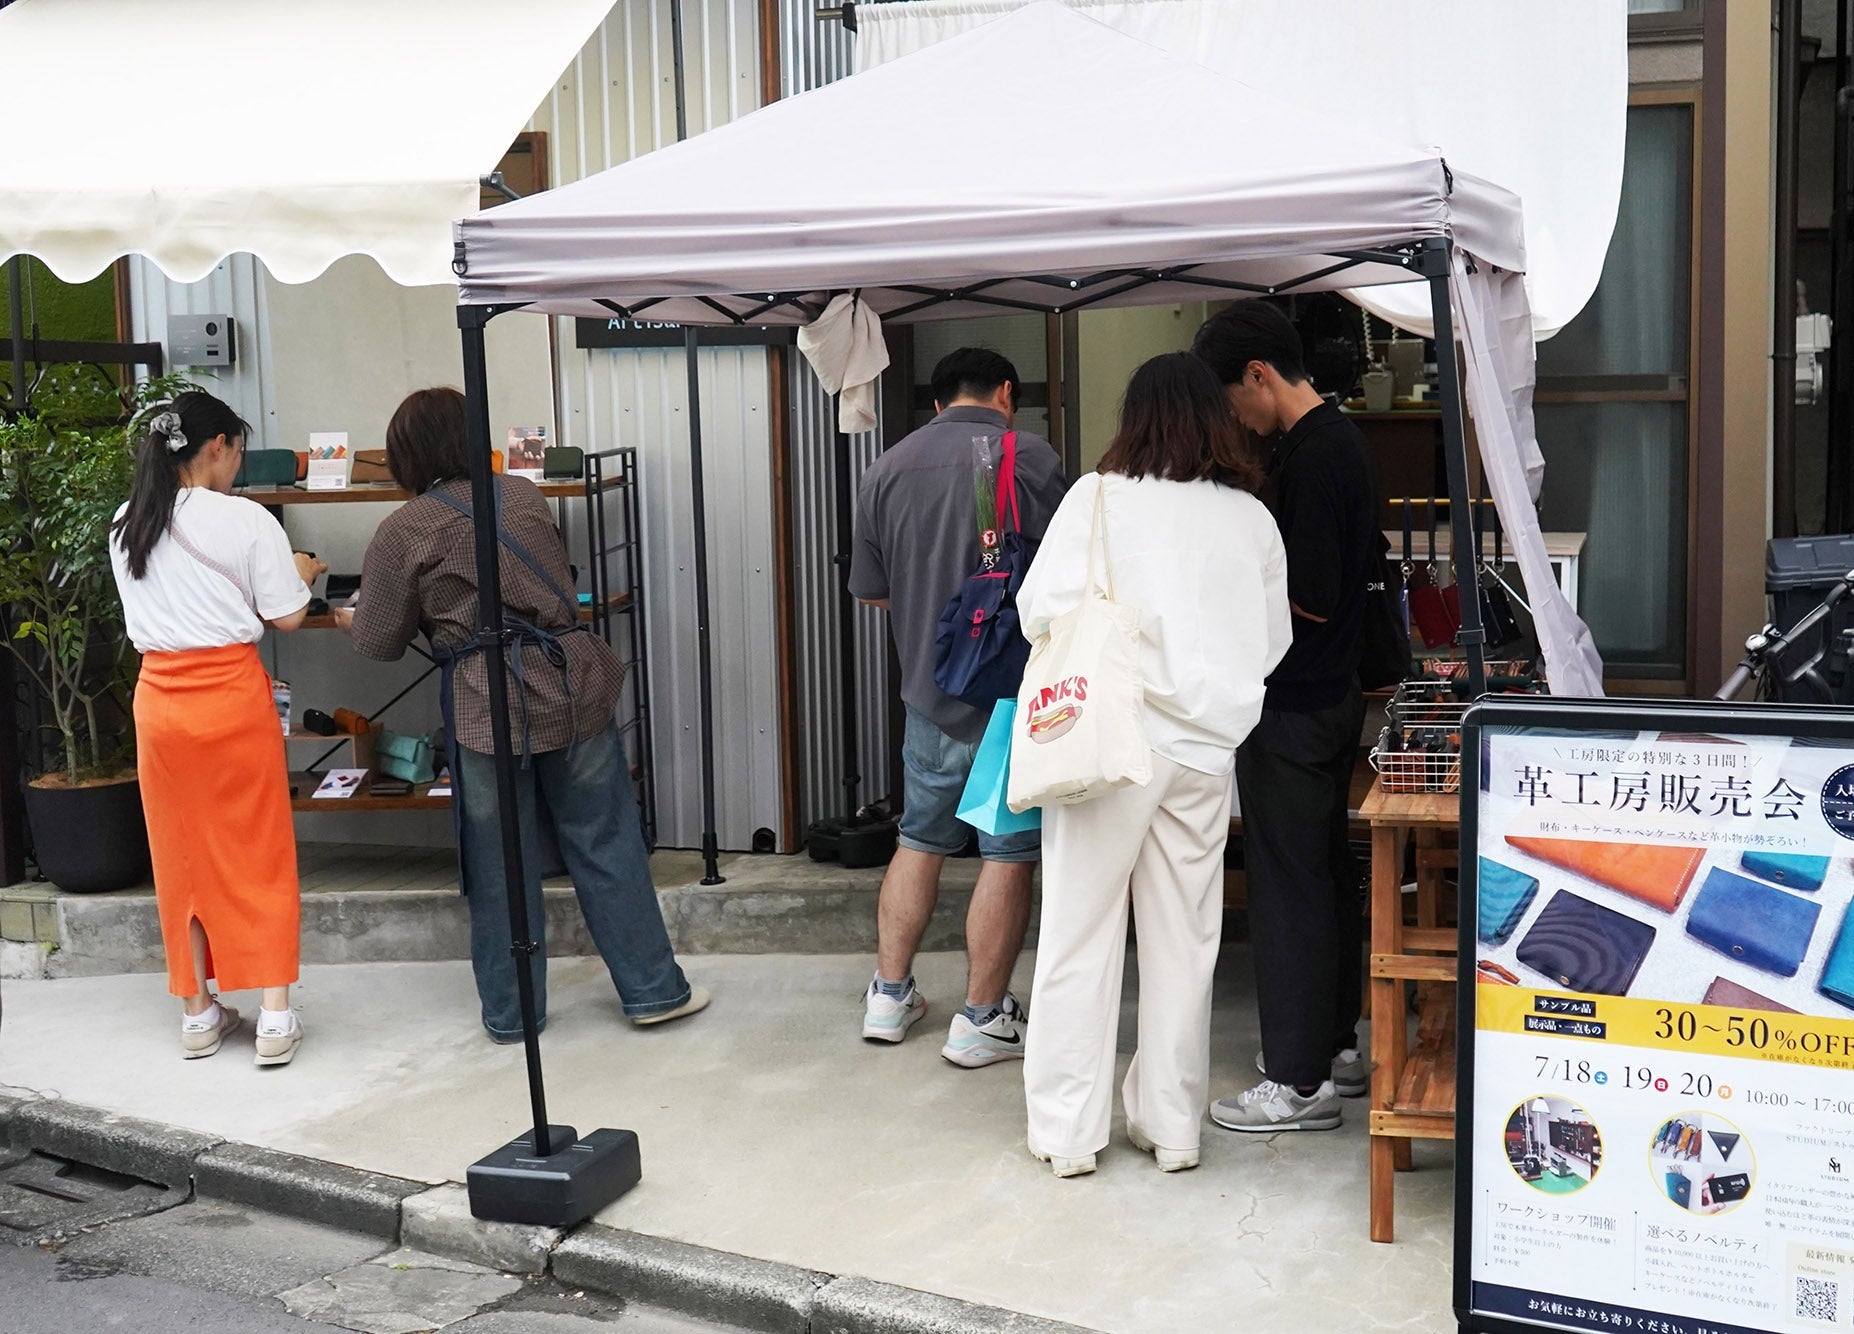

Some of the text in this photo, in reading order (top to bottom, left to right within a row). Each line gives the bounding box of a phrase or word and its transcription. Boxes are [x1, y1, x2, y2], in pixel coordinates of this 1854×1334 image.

[1513, 765, 1807, 820] 革工房販売会
[1540, 999, 1592, 1014] サンプル品
[1528, 1018, 1602, 1035] 展示品・一点もの
[1535, 1055, 1591, 1083] 7/18
[1623, 1066, 1651, 1090] 19
[1680, 1072, 1713, 1098] 20
[1746, 1090, 1789, 1107] 10:00
[1498, 1202, 1617, 1231] ワークショップ開催
[1647, 1225, 1760, 1253] 選べるノベルティ
